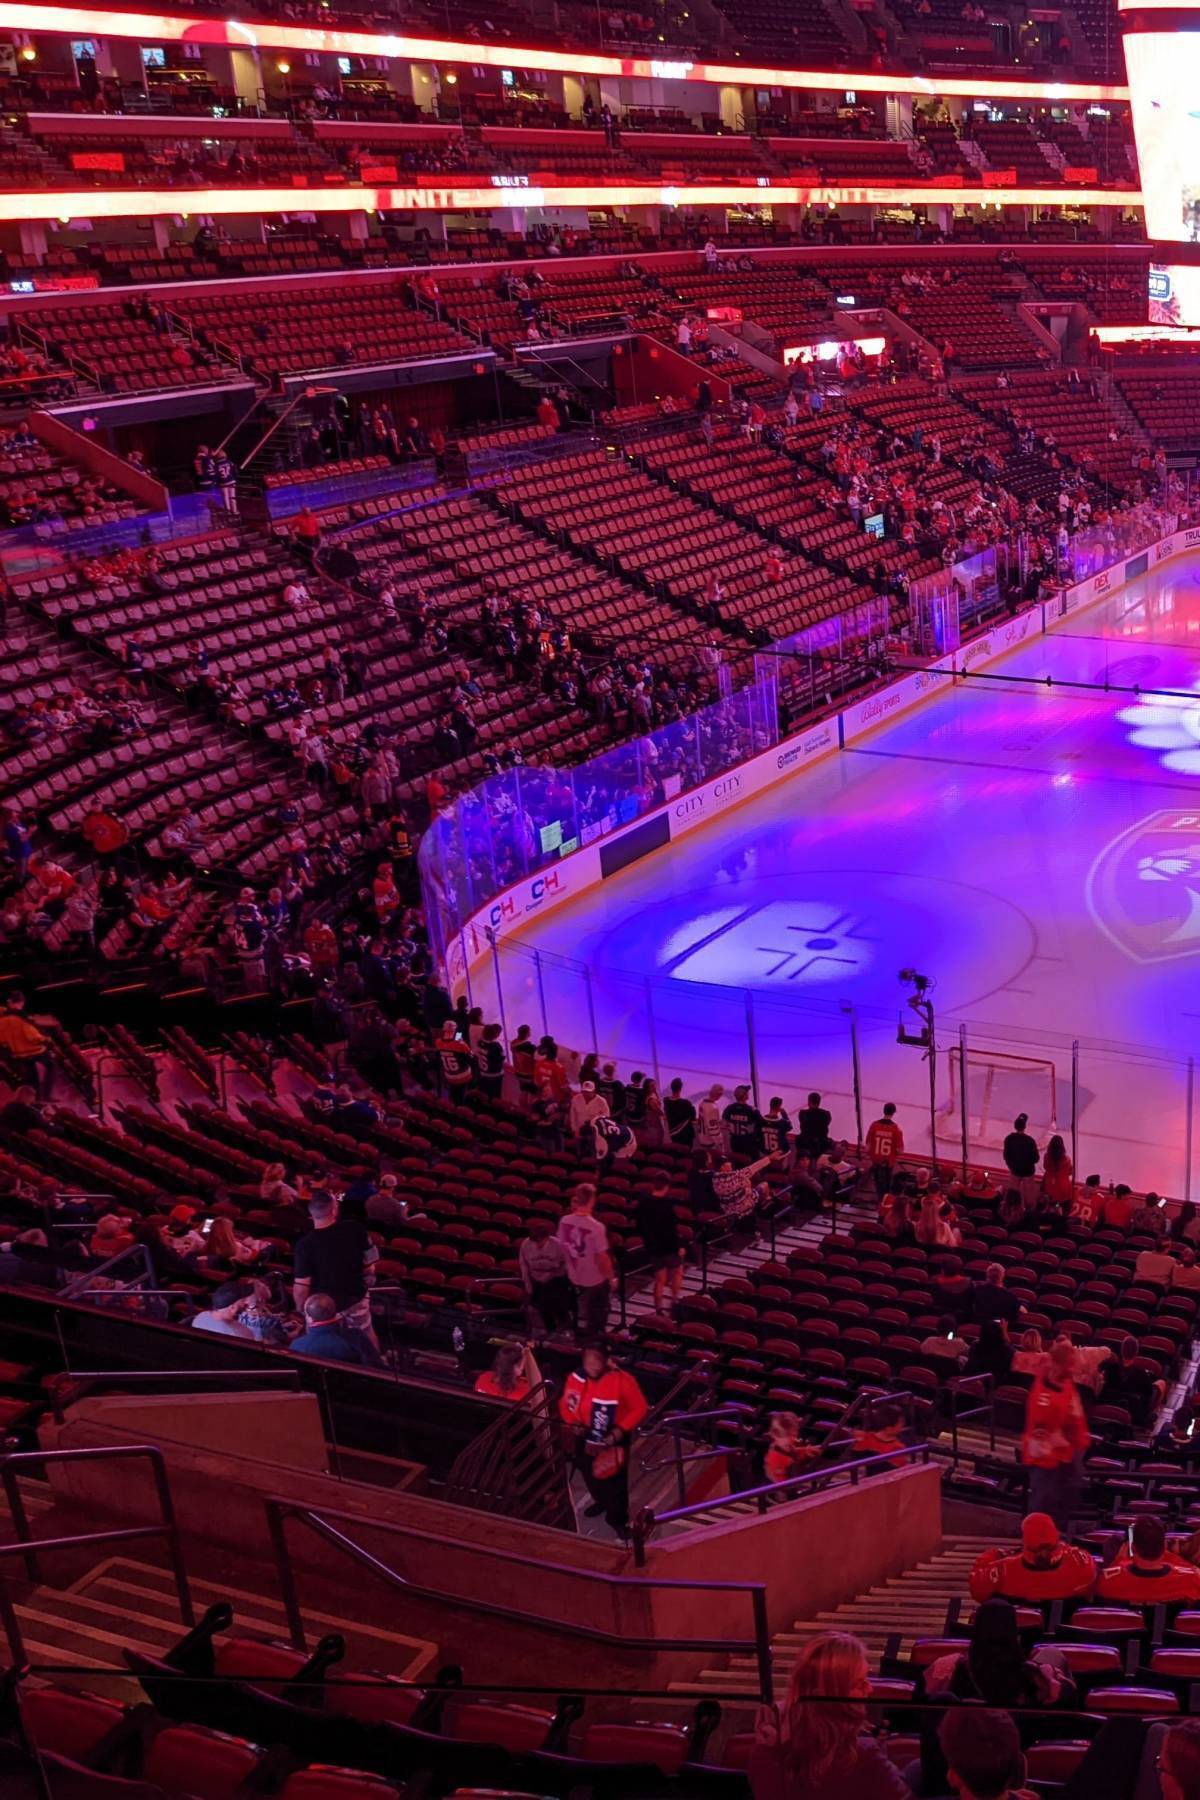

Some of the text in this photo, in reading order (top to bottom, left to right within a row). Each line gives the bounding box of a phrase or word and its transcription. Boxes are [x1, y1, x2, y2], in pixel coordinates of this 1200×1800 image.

[713, 774, 741, 798] CITY
[676, 793, 705, 818] CITY
[532, 871, 559, 899] CH
[490, 897, 515, 926] CH
[763, 1132, 779, 1151] 16
[875, 1137, 892, 1156] 16
